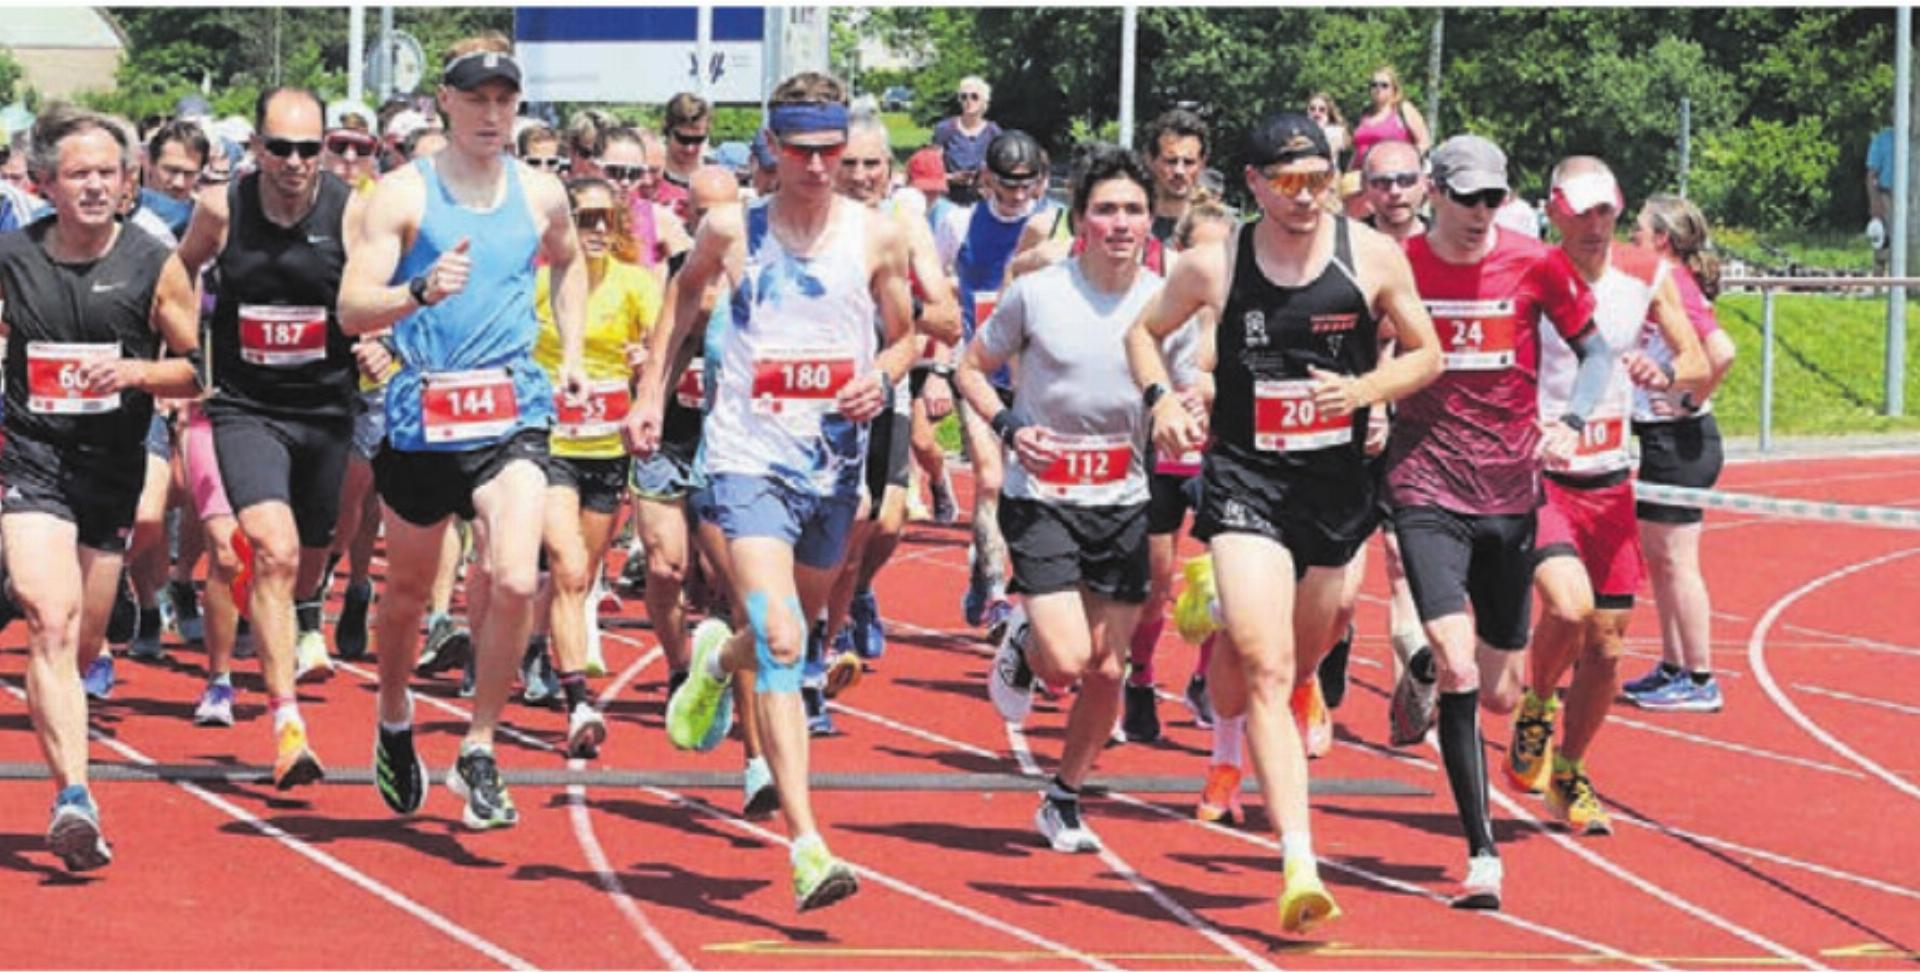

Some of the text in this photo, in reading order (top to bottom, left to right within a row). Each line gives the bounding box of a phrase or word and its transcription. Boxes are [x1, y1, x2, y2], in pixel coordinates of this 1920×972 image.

[262, 322, 305, 345] 187
[1451, 320, 1483, 346] 24
[782, 363, 830, 390] 180
[447, 388, 495, 417] 144
[1067, 453, 1109, 477] 112
